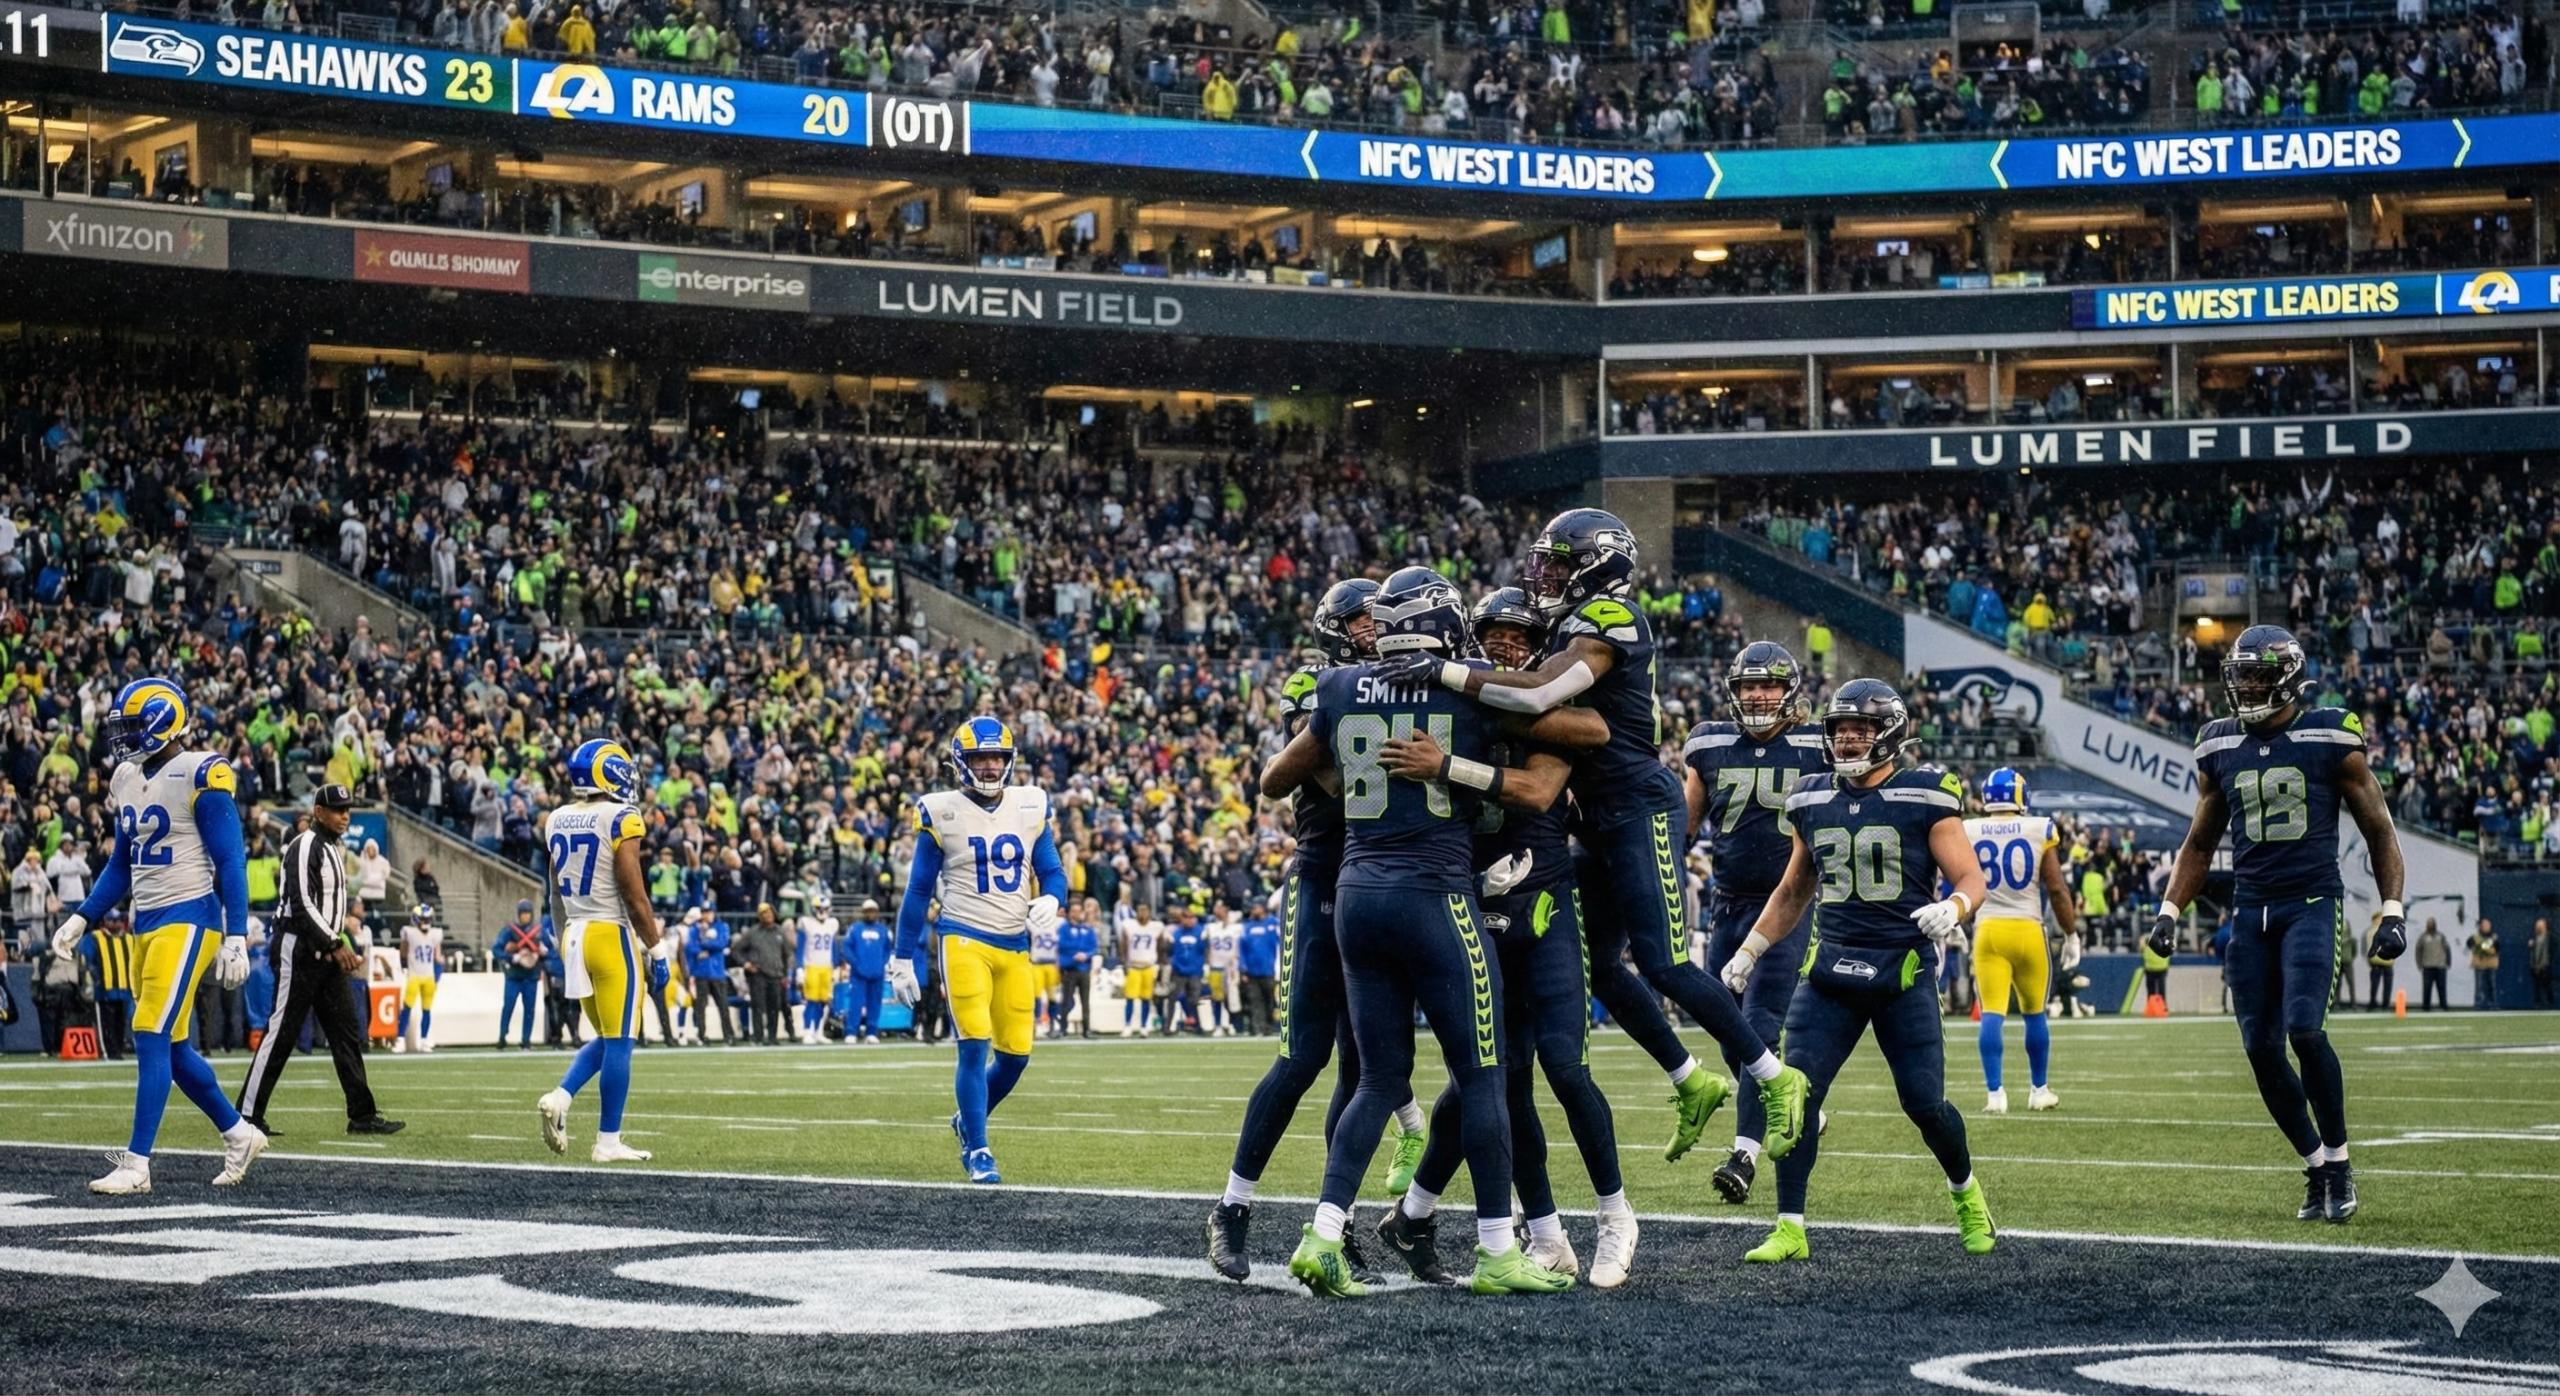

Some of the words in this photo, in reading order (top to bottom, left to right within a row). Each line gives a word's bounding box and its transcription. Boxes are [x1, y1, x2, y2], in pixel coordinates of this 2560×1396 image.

[216, 35, 427, 96] SEAHAWKS
[444, 58, 494, 103] 23
[632, 77, 737, 126] RAMS
[803, 94, 850, 137] 20
[882, 97, 954, 151] (OT)
[1360, 140, 1421, 179] NFC
[1426, 145, 1514, 185] WEST
[1518, 151, 1655, 194] LEADERS
[2057, 142, 2126, 179] NFC
[2133, 137, 2234, 177] WEST
[2241, 128, 2402, 171] LEADERS
[639, 267, 805, 297] enterprise
[879, 280, 1043, 320] LUMEN
[1058, 291, 1183, 326] FIELD
[2107, 291, 2167, 324] NFC
[2173, 288, 2258, 320] WEST
[2264, 282, 2400, 317] LEADERS
[1930, 430, 2152, 466] LUMEN
[2188, 422, 2412, 459] FIELD
[1356, 676, 1429, 704] SMITH
[1337, 713, 1453, 819] 84
[1717, 767, 1800, 836] 74
[550, 832, 601, 898] 27
[968, 833, 1025, 894] 19
[1813, 825, 1903, 904] 30
[1973, 837, 2035, 891] 80
[378, 995, 396, 1026] G
[69, 1031, 96, 1056] 20
